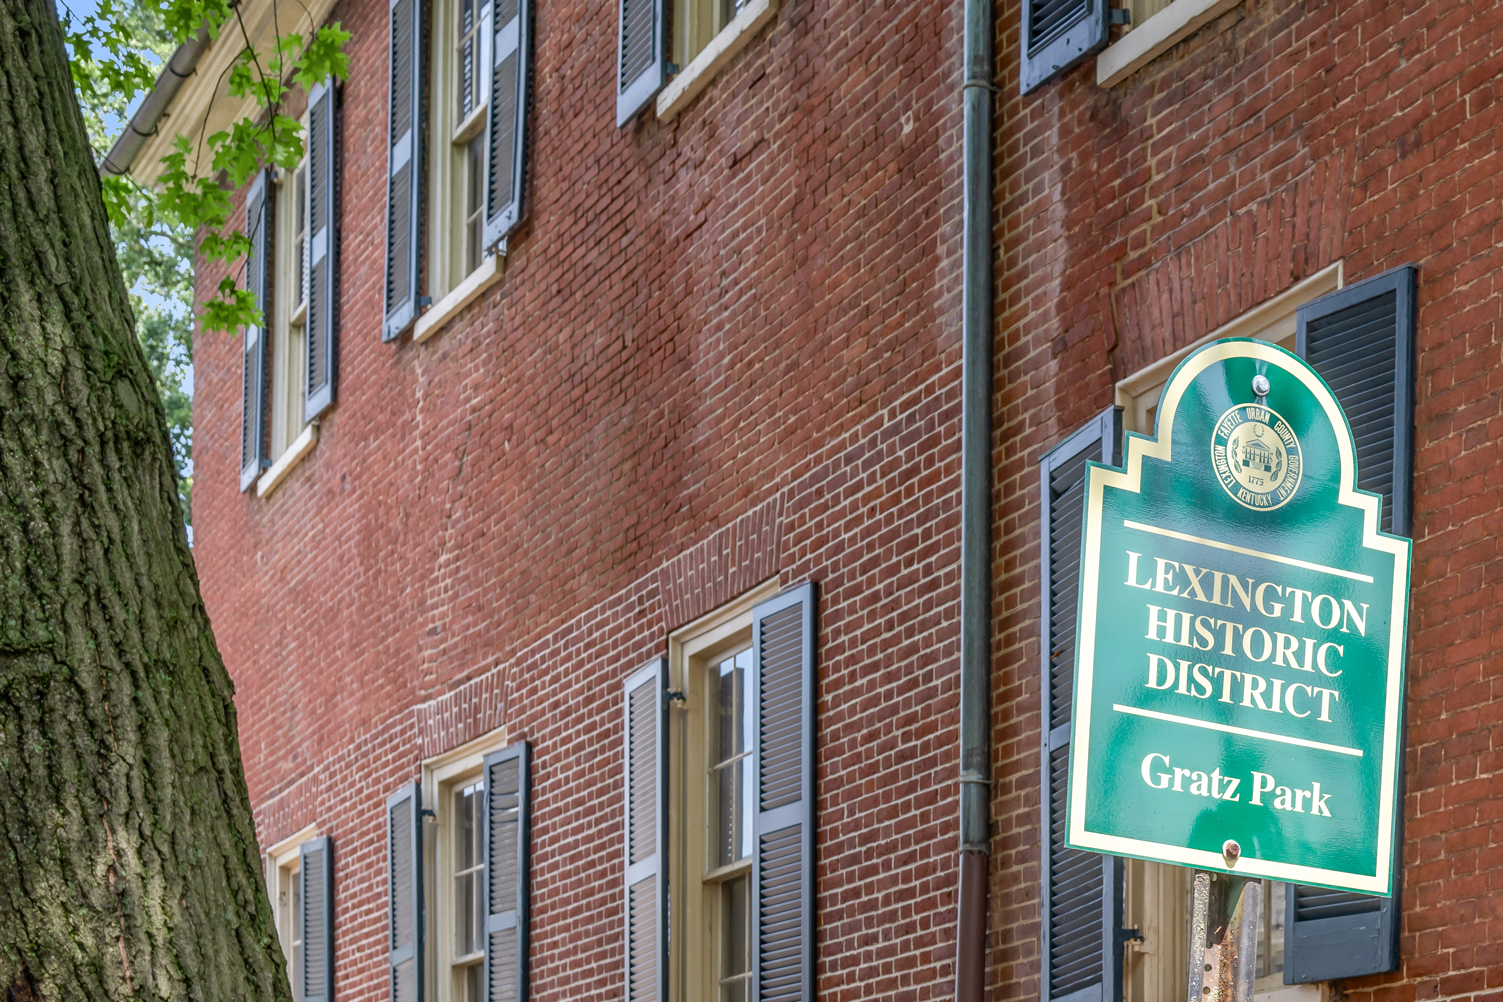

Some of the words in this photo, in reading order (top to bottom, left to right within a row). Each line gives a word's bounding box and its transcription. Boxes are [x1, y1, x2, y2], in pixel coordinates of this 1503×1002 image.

[1218, 411, 1242, 438] FAYETTE
[1246, 408, 1270, 423] URBAN
[1274, 421, 1296, 447] COUNTY
[1215, 445, 1236, 488] LEXINGTON
[1248, 475, 1264, 486] 1775
[1277, 455, 1298, 500] GOVERNMENT
[1237, 488, 1272, 506] KENTUCKY
[1124, 550, 1369, 637] LEXINGTON
[1145, 604, 1344, 677] HISTORIC
[1145, 653, 1339, 723] DISTRICT
[1141, 753, 1240, 801] Gratz
[1249, 771, 1332, 817] Park
